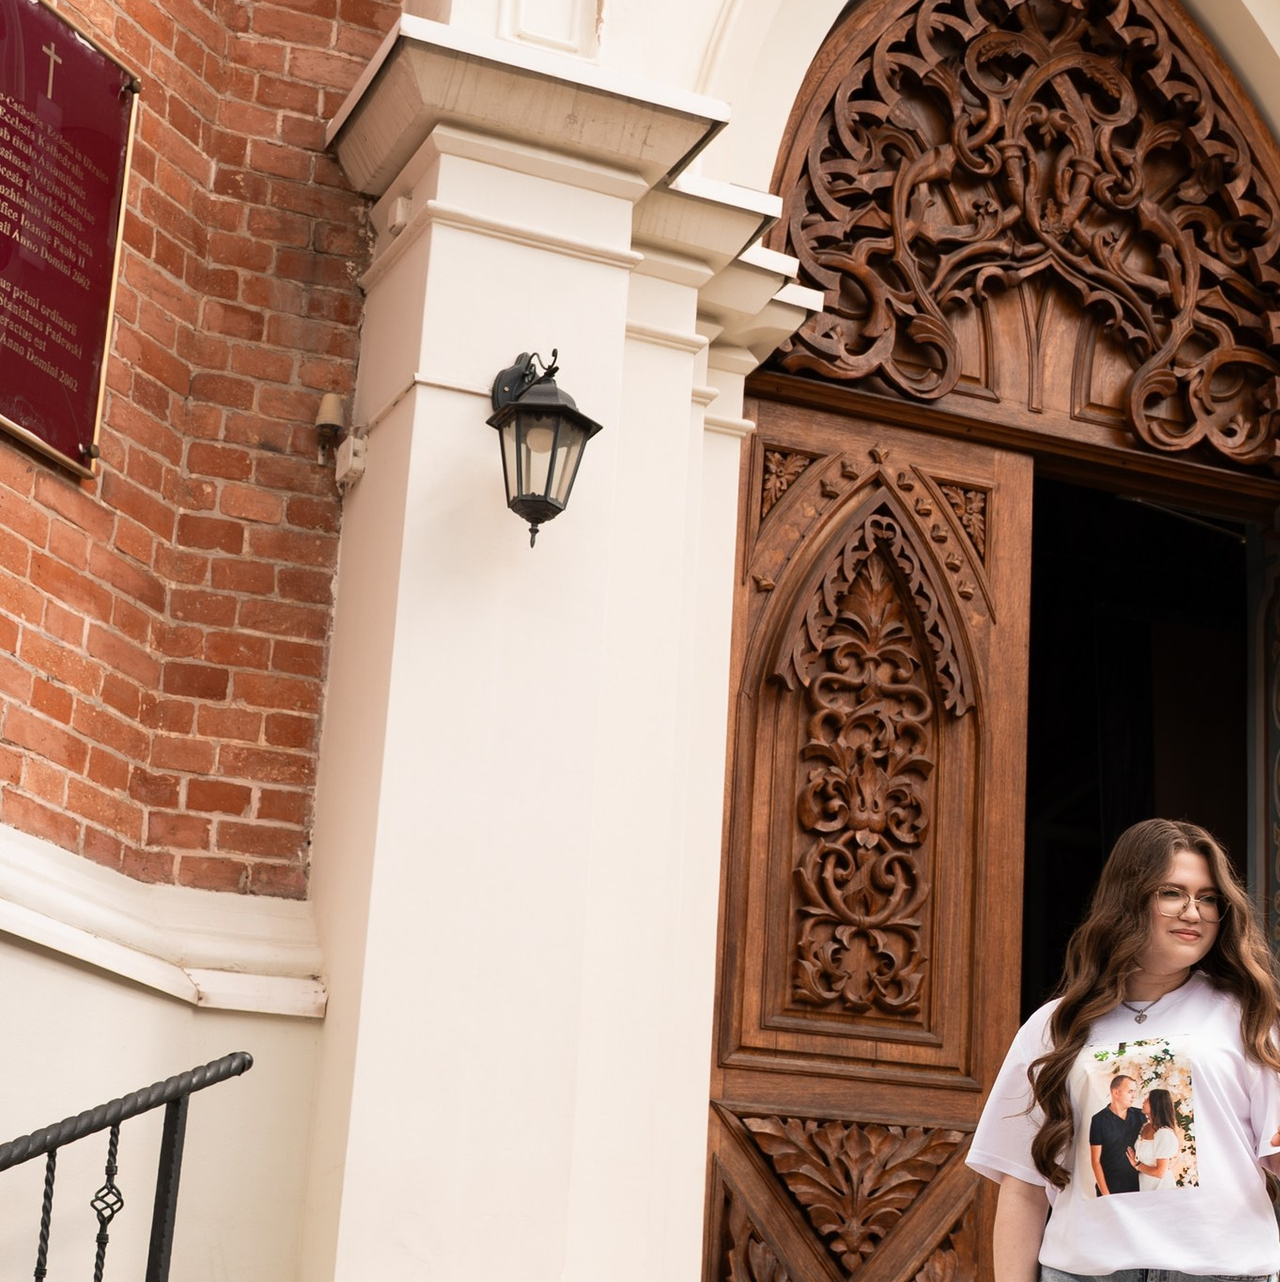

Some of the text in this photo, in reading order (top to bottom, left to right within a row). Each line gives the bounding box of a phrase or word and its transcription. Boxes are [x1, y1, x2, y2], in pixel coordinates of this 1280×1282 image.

[12, 228, 38, 253] Anno
[40, 245, 71, 277] Domini
[12, 286, 40, 310] primi
[33, 337, 46, 352] est
[26, 348, 59, 378] Domini
[59, 370, 78, 392] 2002
